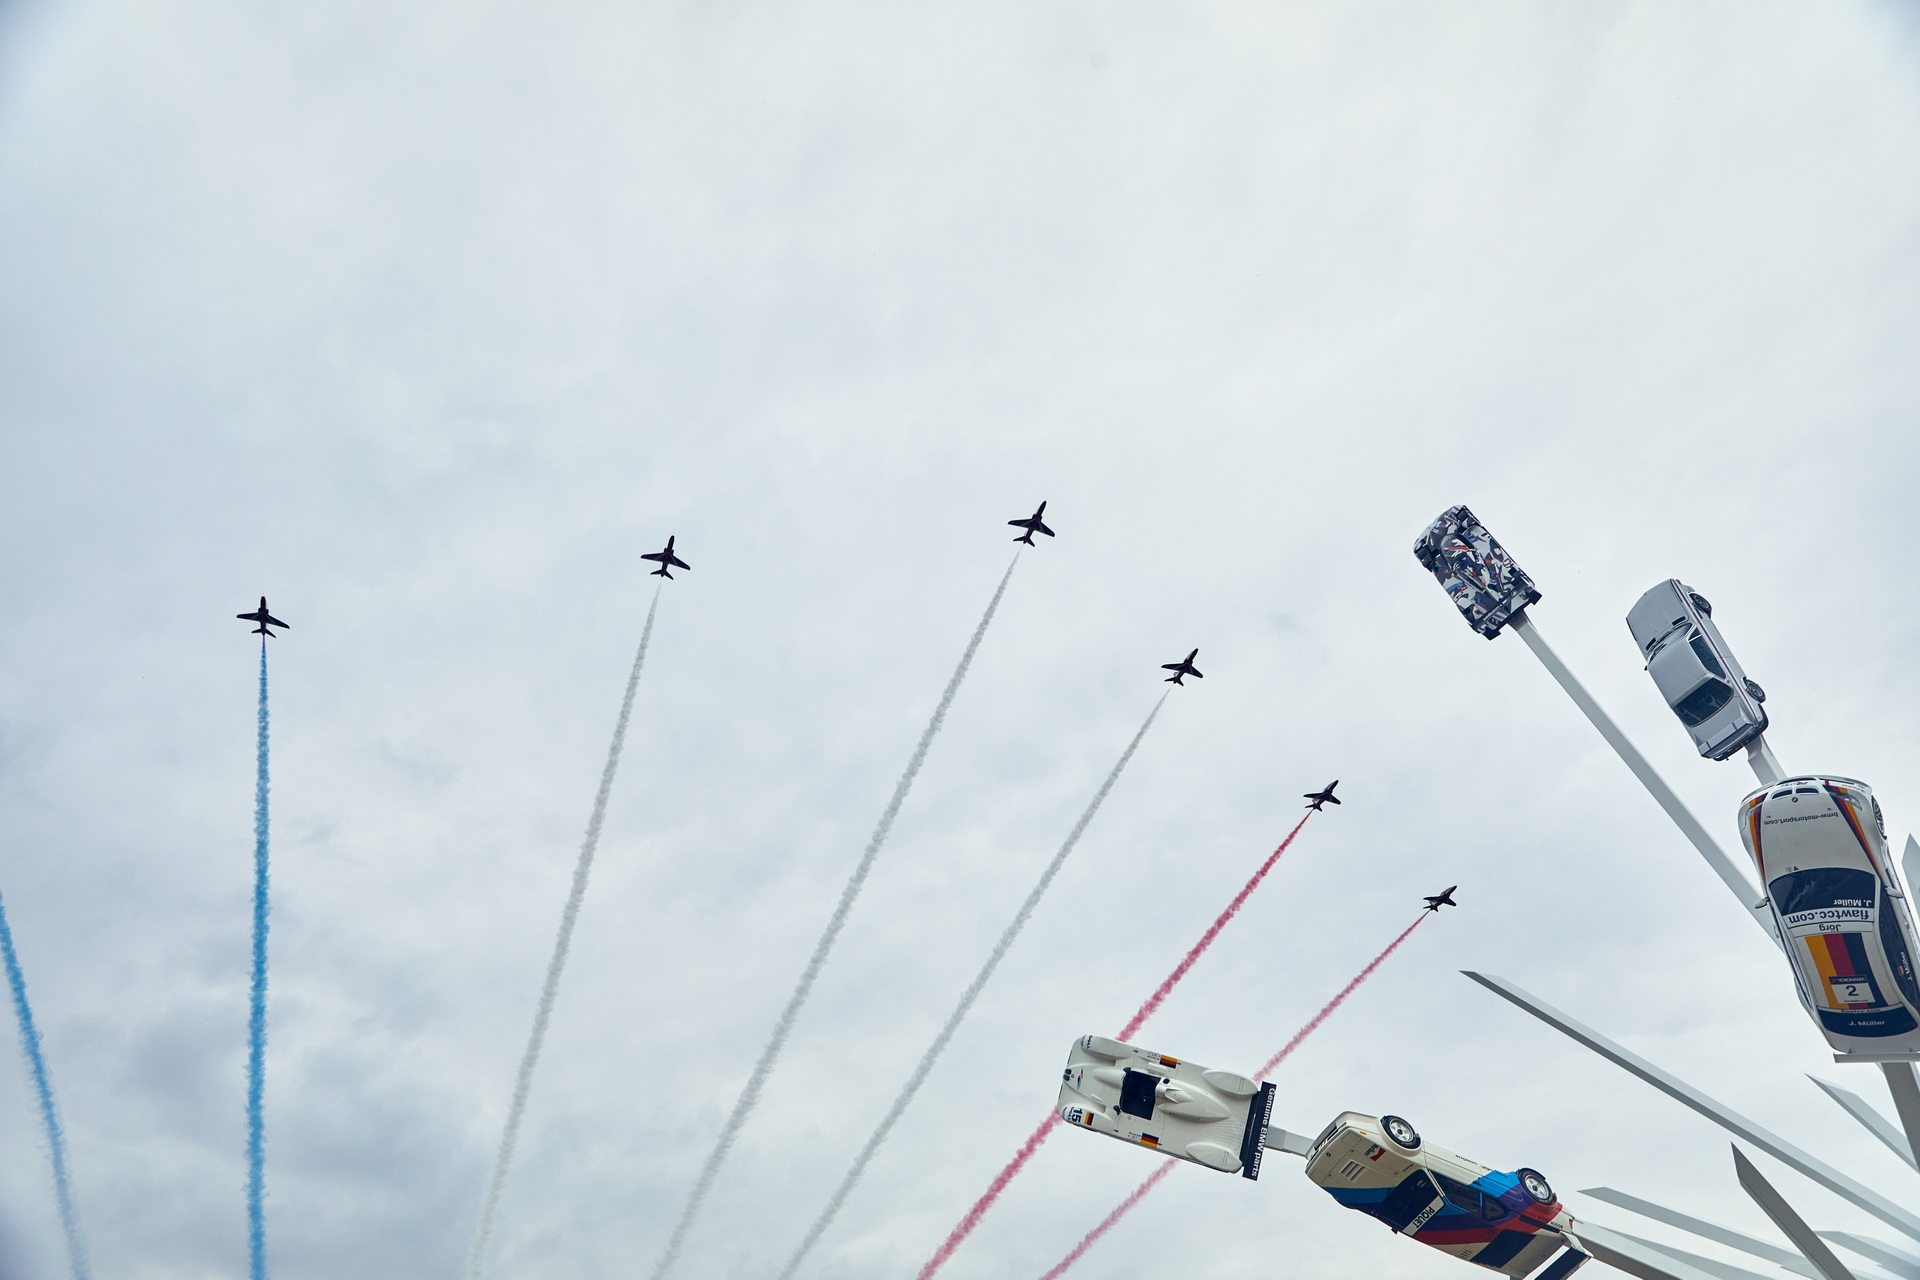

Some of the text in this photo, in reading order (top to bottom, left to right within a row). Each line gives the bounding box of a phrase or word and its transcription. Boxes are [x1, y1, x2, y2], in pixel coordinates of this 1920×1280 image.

[1764, 812, 1838, 825] bmw-motorsport.com
[1833, 898, 1862, 906] Müller
[1788, 909, 1869, 924] fiawtcc.com
[1818, 923, 1842, 932] Jörg
[1845, 985, 1859, 997] 2
[1073, 1108, 1083, 1123] 15
[1251, 1088, 1275, 1177] Genuine BMW parts
[1412, 1207, 1436, 1228] PIQUET
